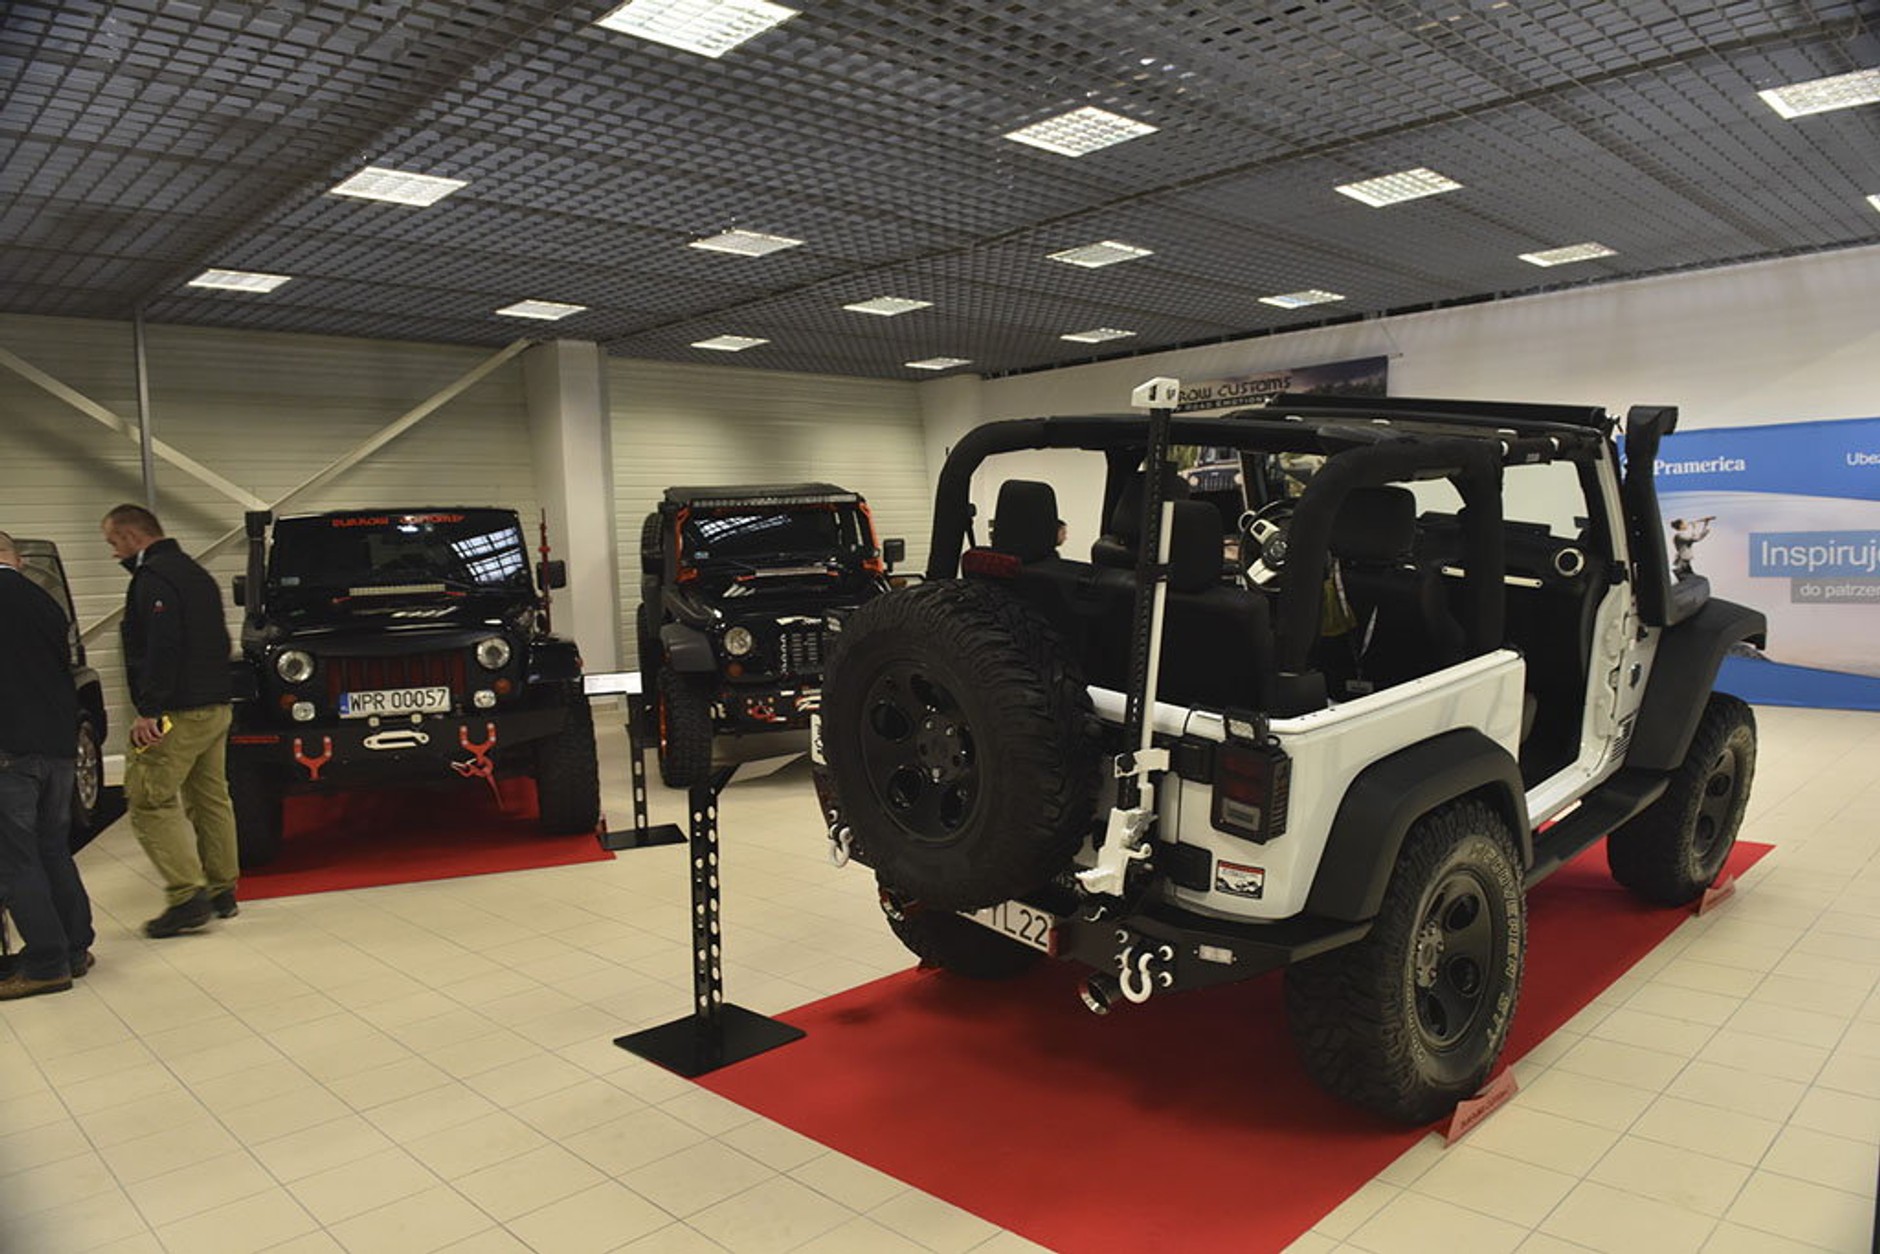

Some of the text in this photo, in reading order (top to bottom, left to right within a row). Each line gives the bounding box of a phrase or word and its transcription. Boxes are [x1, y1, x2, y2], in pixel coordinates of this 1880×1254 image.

[1217, 376, 1291, 397] CUSTOMS
[1653, 456, 1746, 476] Pramerica
[1762, 539, 1880, 573] Inspiruj
[1800, 583, 1821, 597] do
[350, 688, 447, 712] WPR 00057
